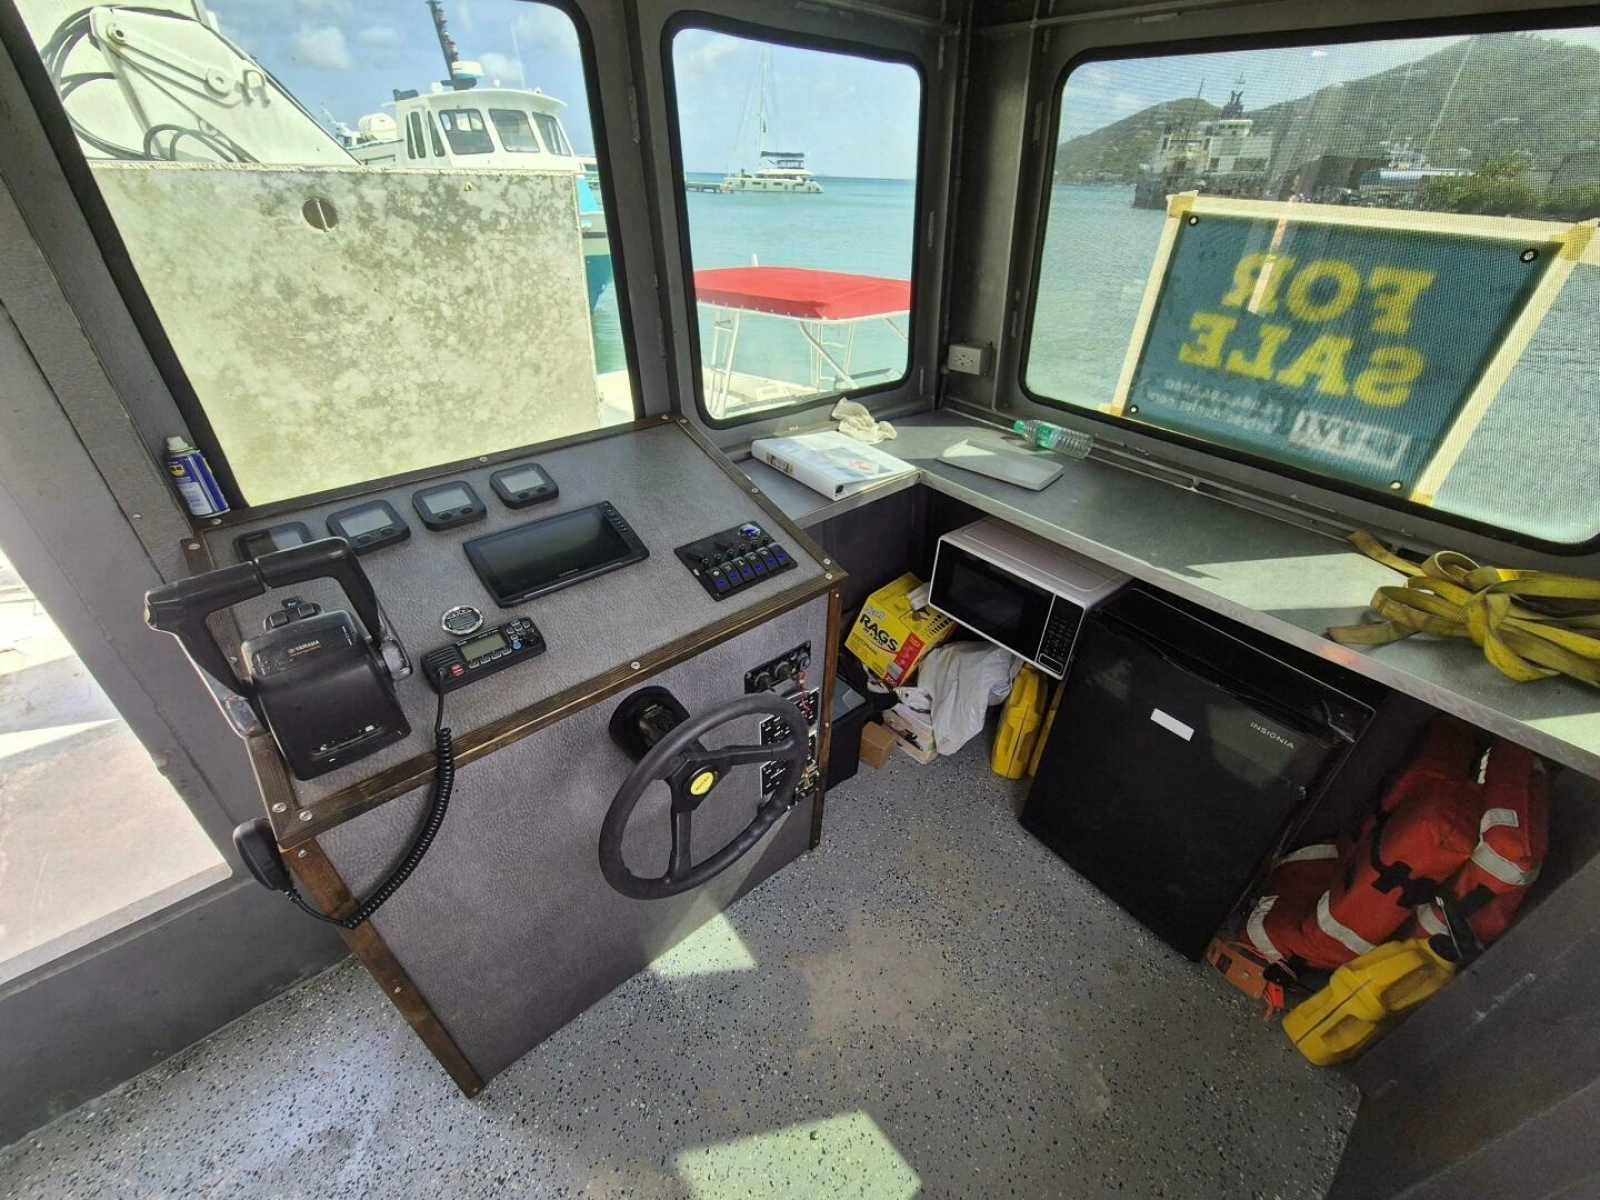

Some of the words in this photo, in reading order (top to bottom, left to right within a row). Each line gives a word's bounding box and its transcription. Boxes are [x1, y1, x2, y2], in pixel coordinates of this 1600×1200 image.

[296, 640, 320, 651] YAMAHA
[860, 614, 898, 651] RAGS
[1250, 721, 1294, 749] INSIGNIA
